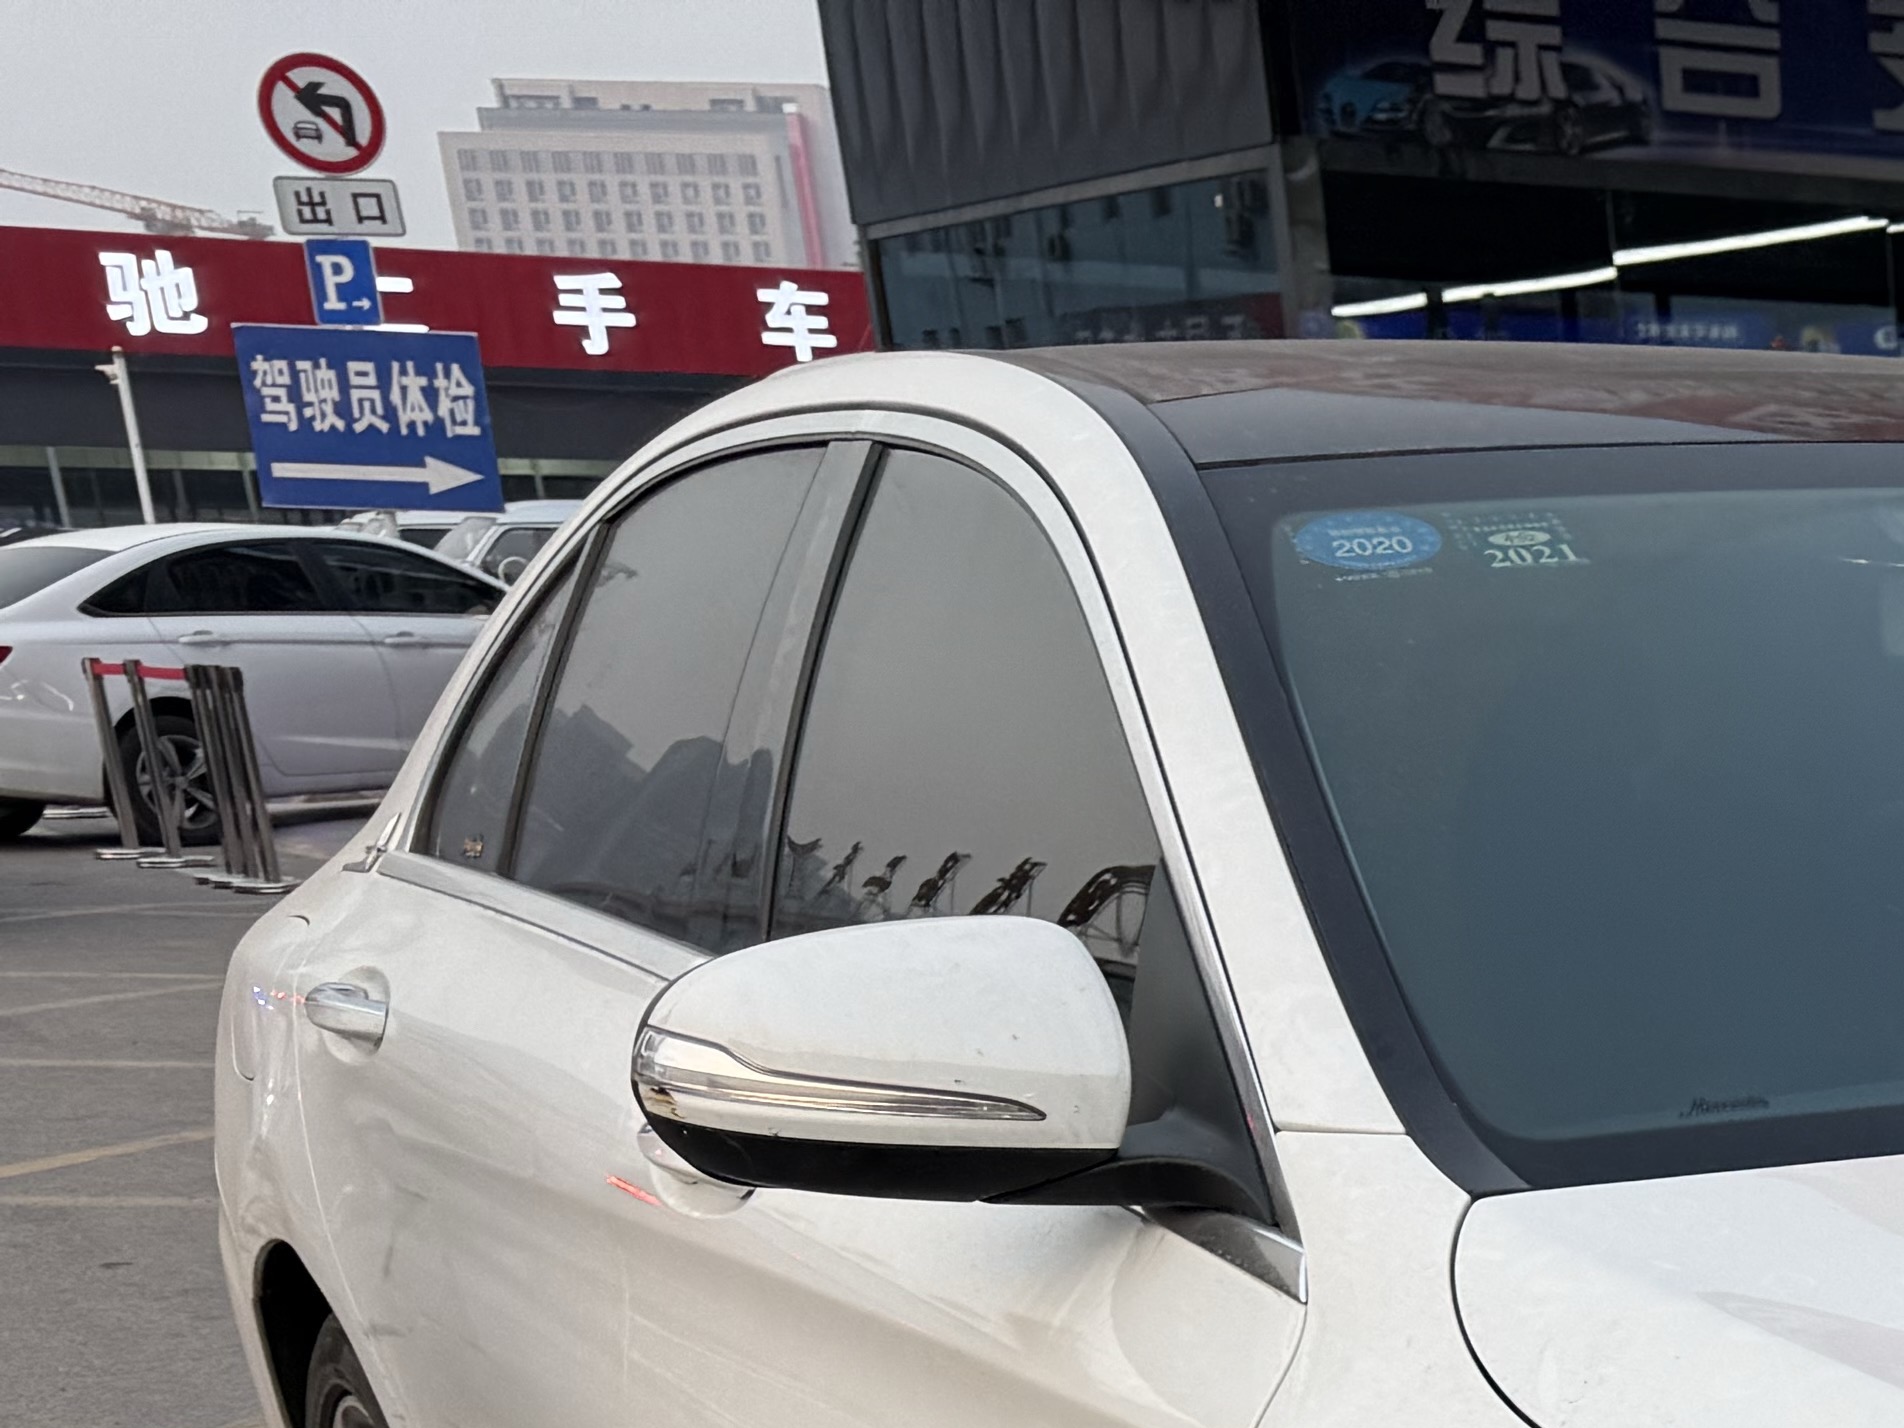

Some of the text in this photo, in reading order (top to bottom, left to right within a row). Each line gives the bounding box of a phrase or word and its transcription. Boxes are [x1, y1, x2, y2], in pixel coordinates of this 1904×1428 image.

[295, 187, 388, 227] 出口
[315, 254, 354, 313] P
[251, 355, 482, 438] 驾驶员体检
[1332, 535, 1414, 558] 2020
[1483, 543, 1582, 568] 2021
